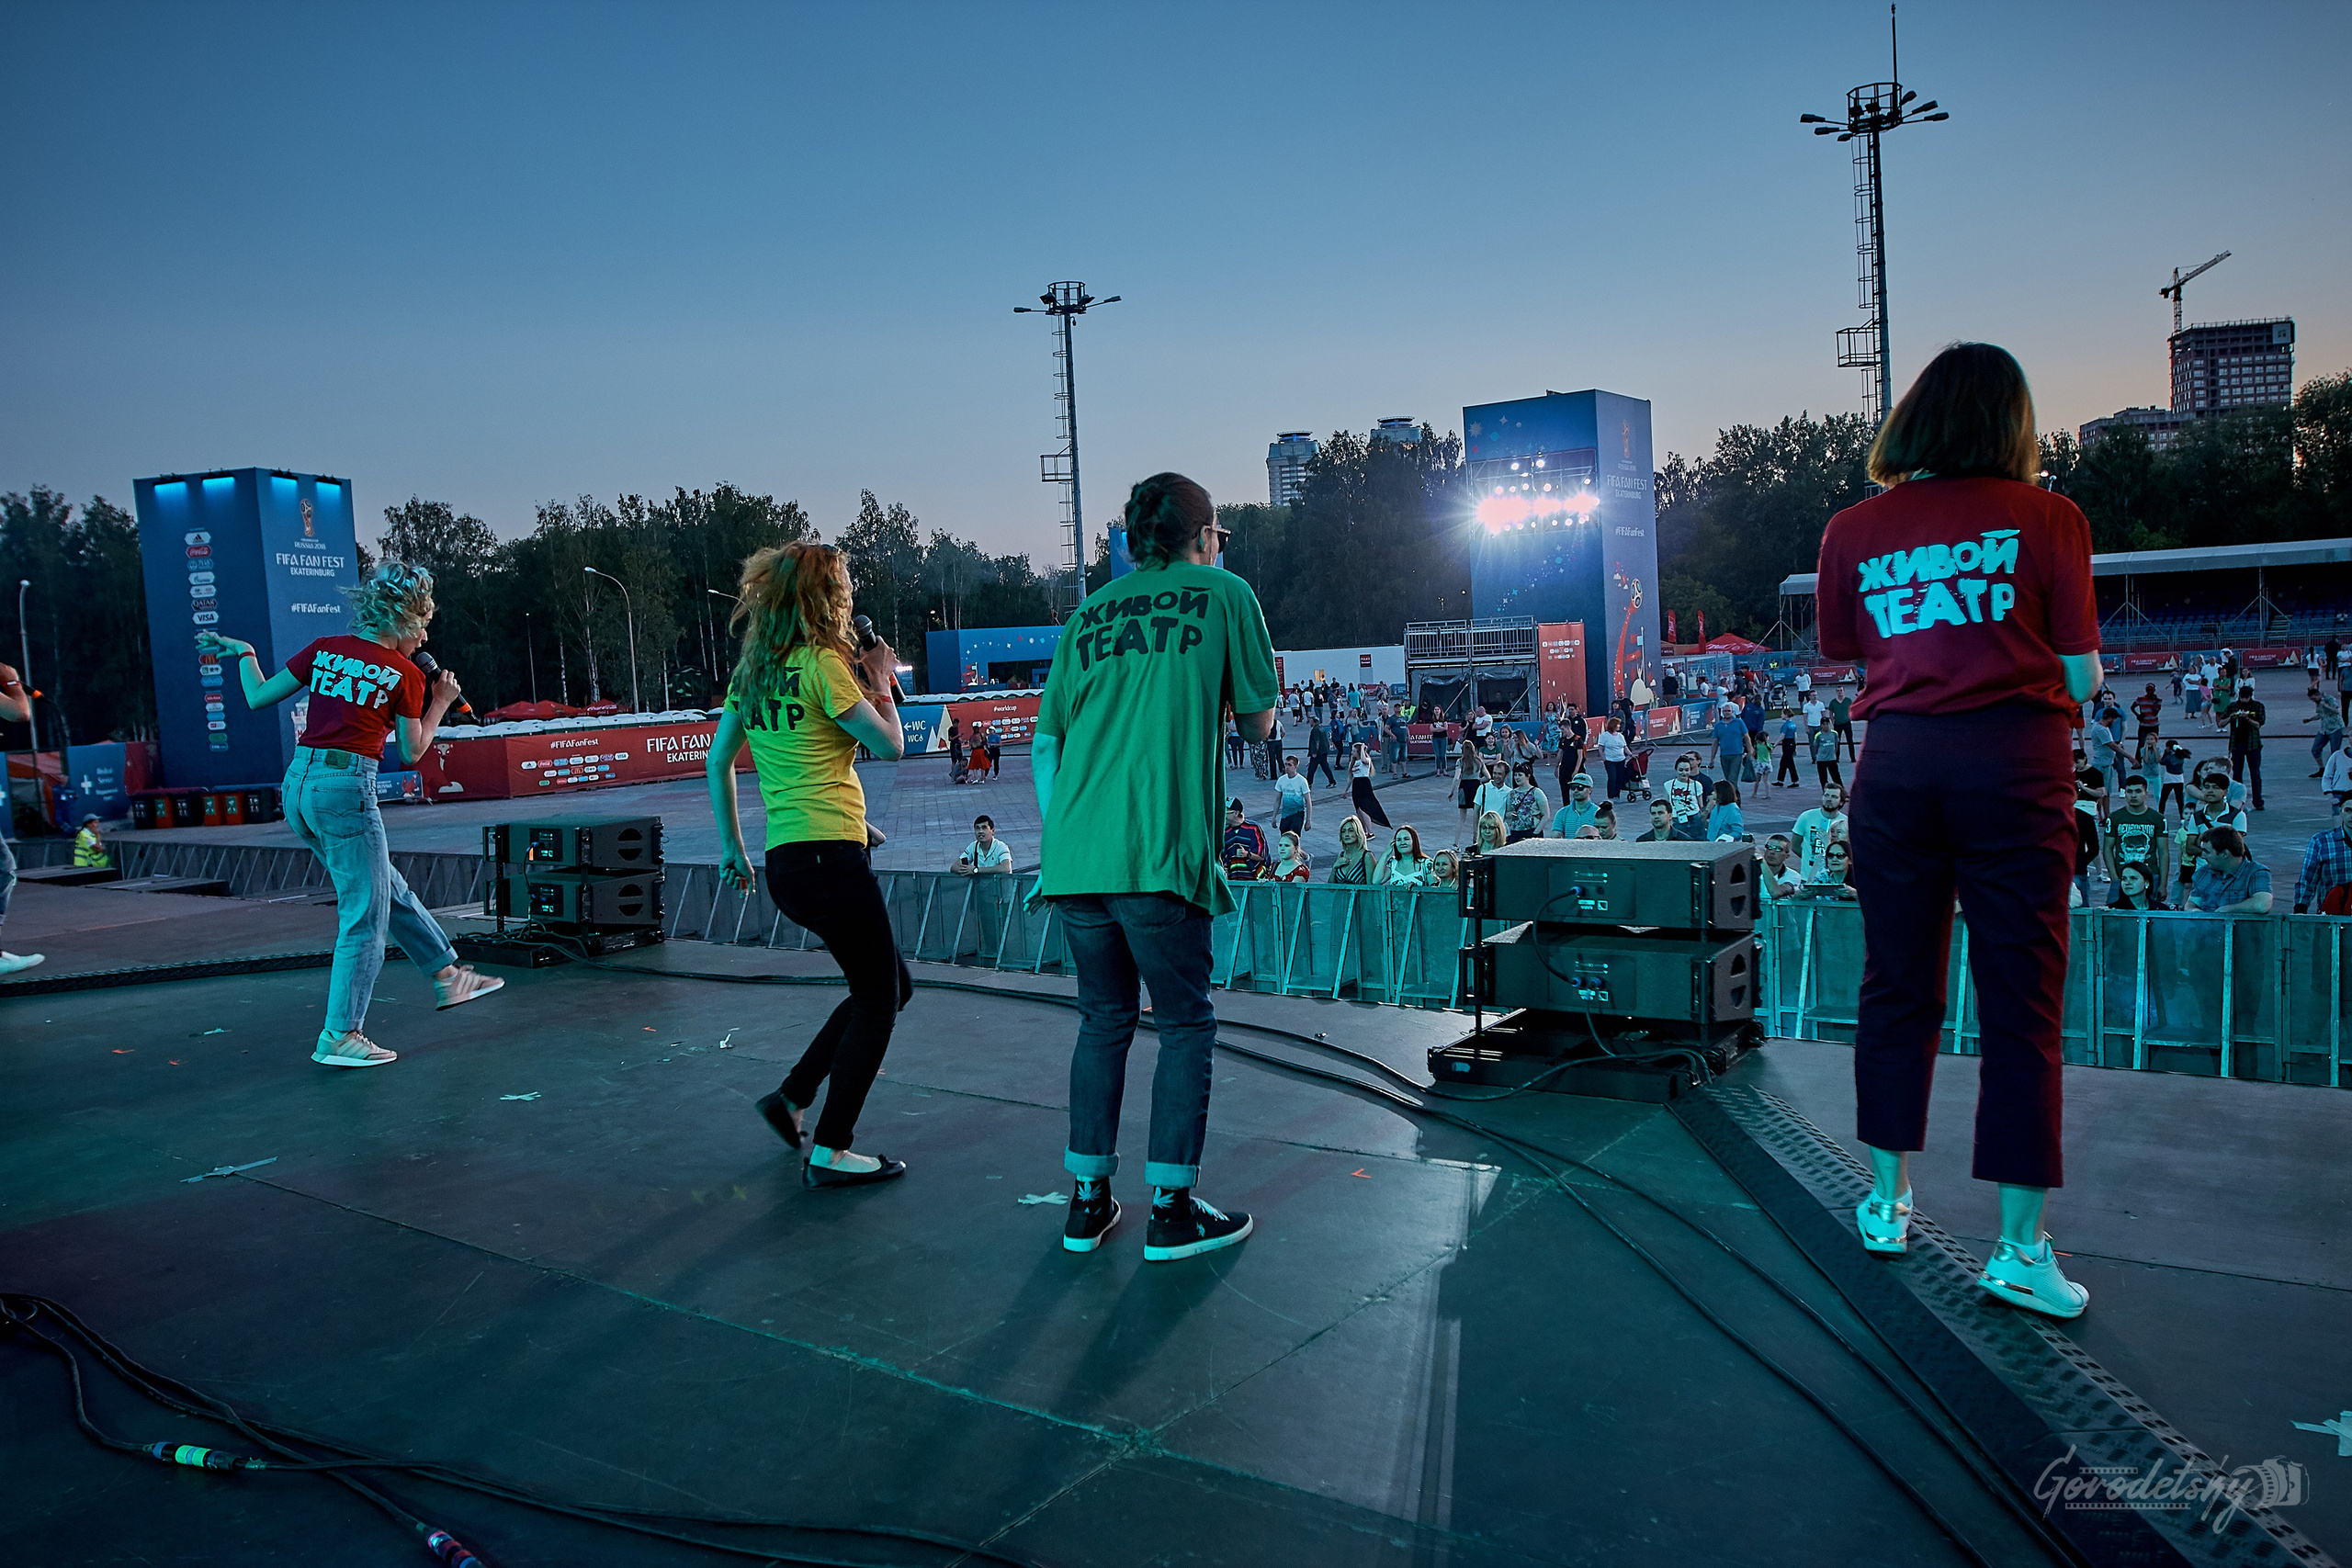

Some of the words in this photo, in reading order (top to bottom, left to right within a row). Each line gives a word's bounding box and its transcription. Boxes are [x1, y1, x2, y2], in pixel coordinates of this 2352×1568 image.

[1634, 478, 1647, 491] FEST
[294, 541, 314, 549] RUSSIA
[276, 553, 299, 566] FIFA
[300, 554, 321, 568] FAN
[322, 556, 345, 569] FEST
[1858, 529, 2020, 592] ЖИВОЙ
[290, 567, 335, 577] EKATERINBURG
[290, 603, 341, 614] #FIFAFanFest
[1077, 586, 1211, 634] ЖИВОЙ
[1863, 577, 2016, 638] ТЕАТР
[197, 614, 215, 622] VISA
[1076, 616, 1203, 671] ТЕАТР
[311, 649, 403, 691] ЖИВОЙ
[310, 667, 389, 709] ТЕАТР
[911, 720, 927, 731] WC
[550, 738, 599, 749] #FIFAFanFest
[646, 736, 680, 753] FIFA
[681, 733, 711, 750] FAN
[666, 750, 711, 763] EKATERIN
[2105, 818, 2111, 834] 3
[2162, 818, 2168, 833] 1
